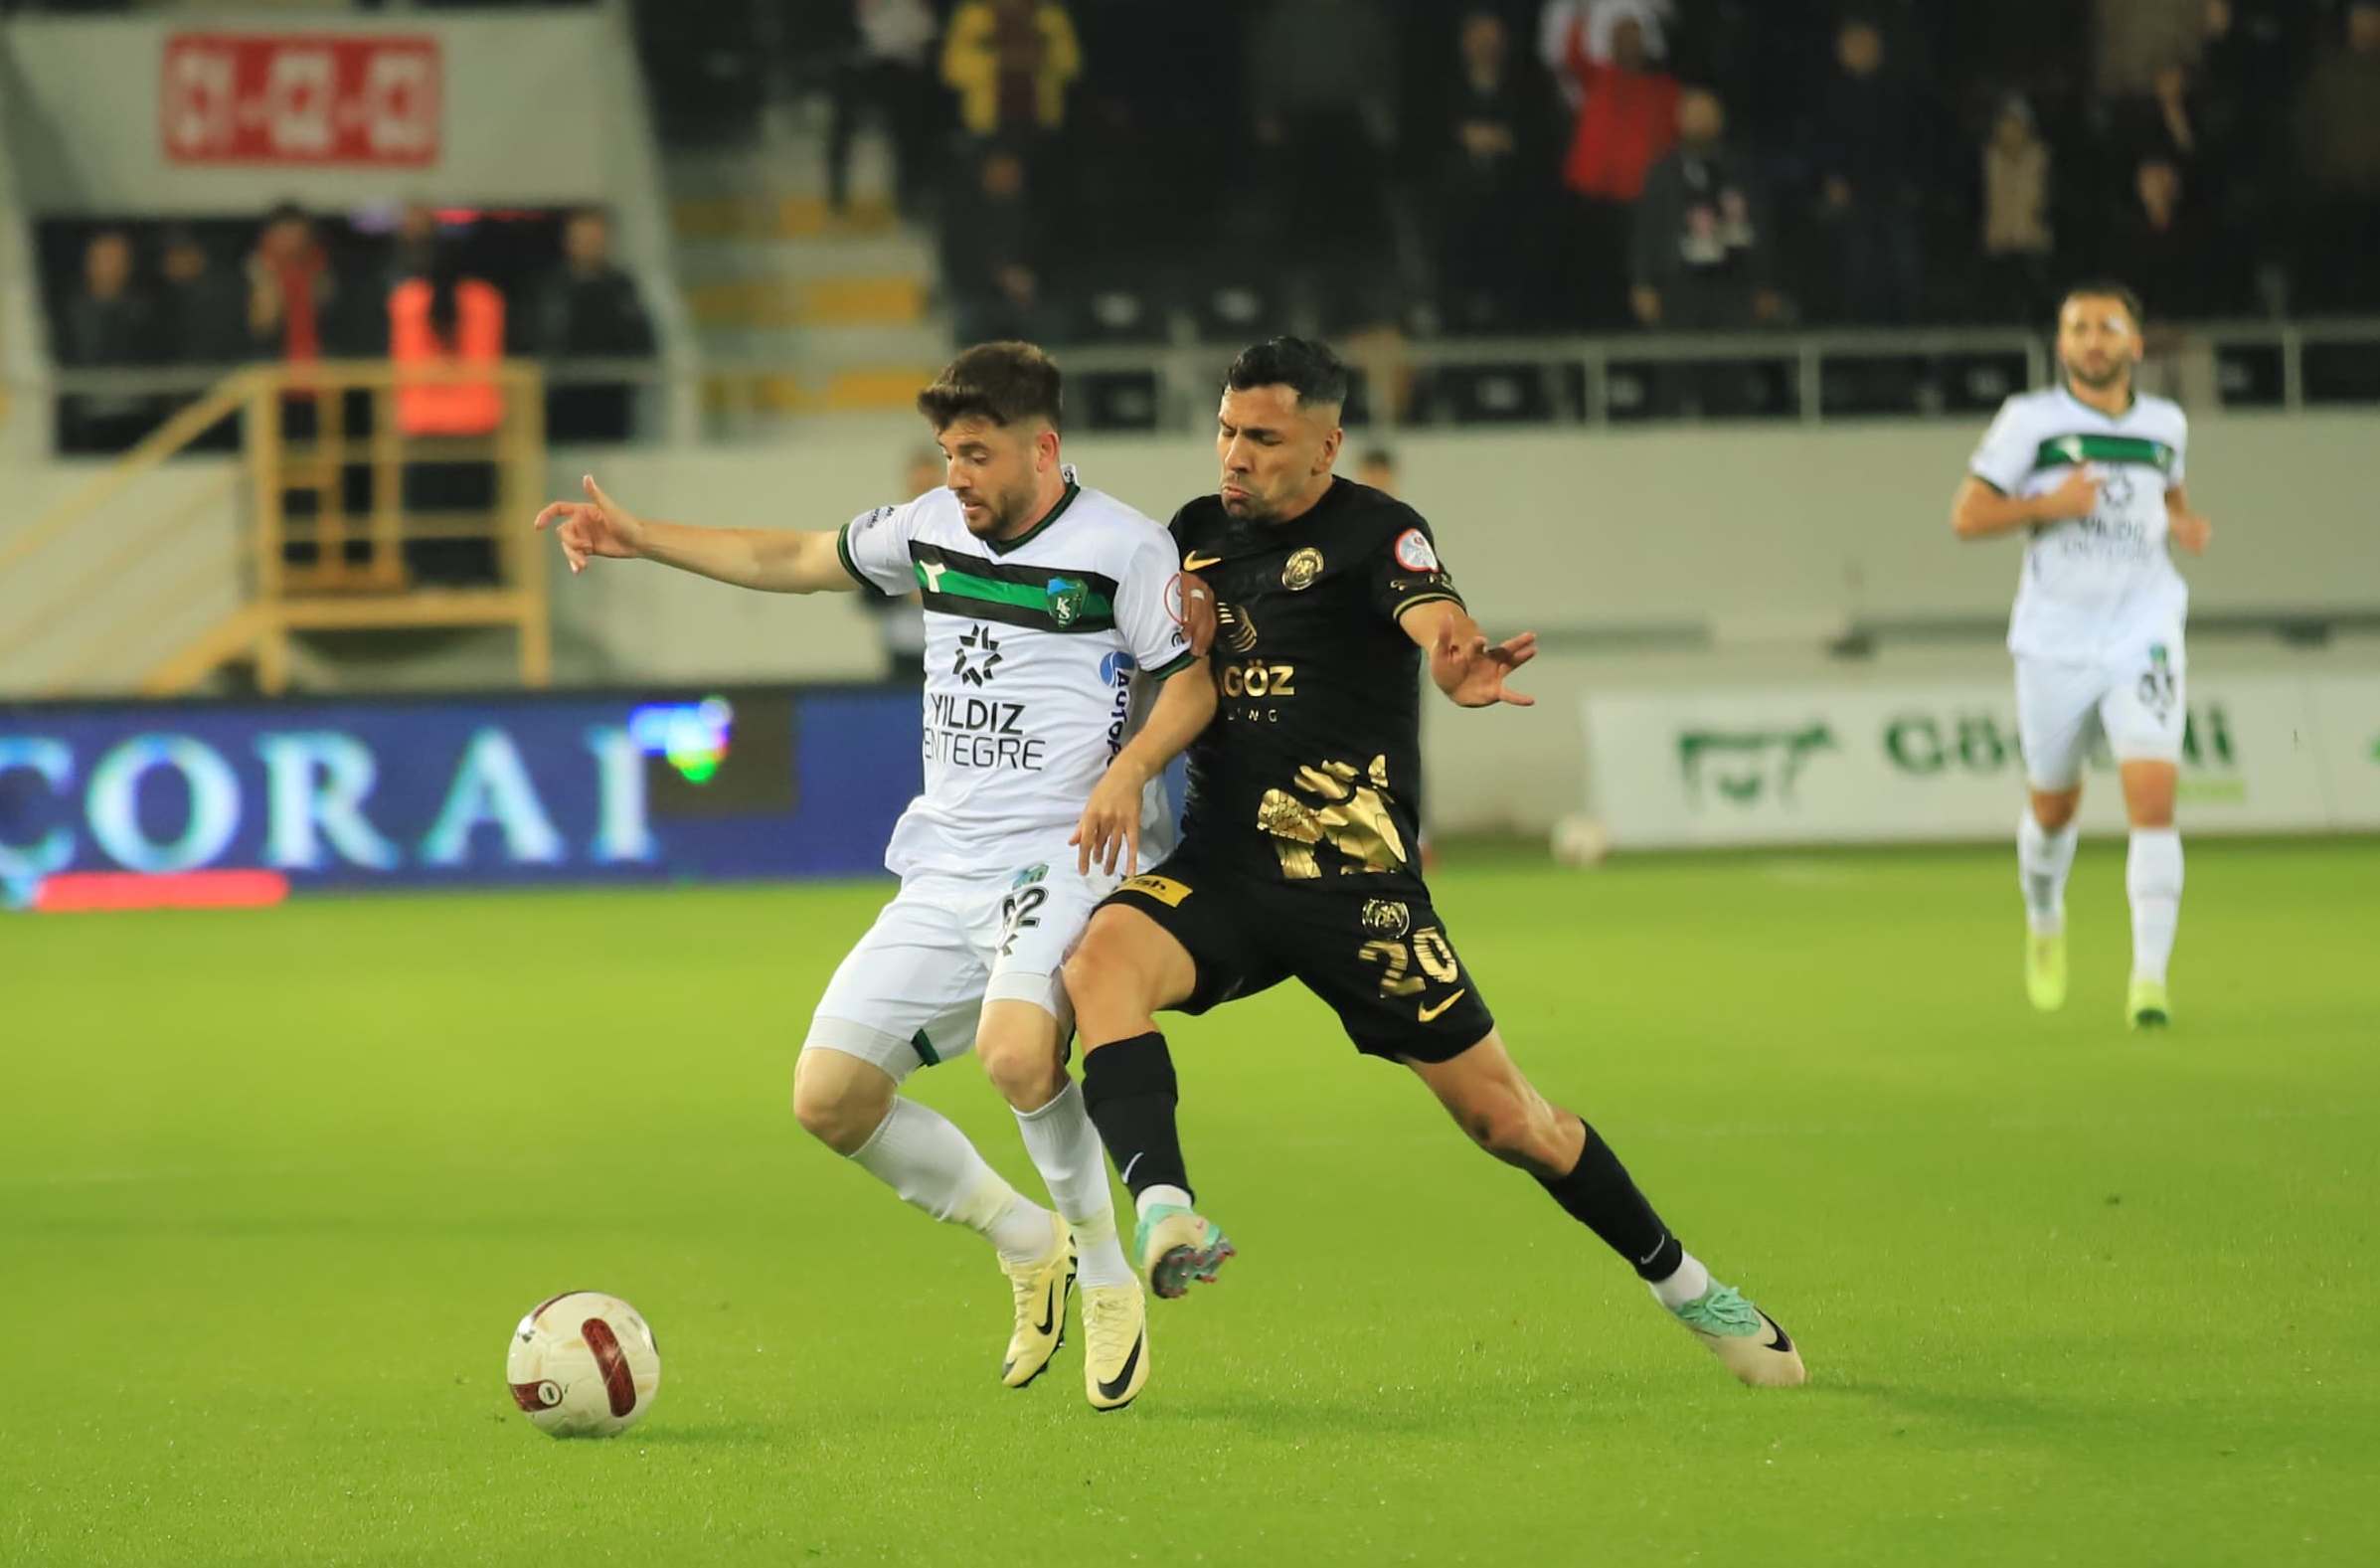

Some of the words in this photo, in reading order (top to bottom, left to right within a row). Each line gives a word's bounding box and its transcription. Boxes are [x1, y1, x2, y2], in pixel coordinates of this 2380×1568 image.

[1222, 658, 1294, 696] GÖZ
[931, 693, 1025, 735] YILDIZ
[924, 728, 1046, 771] ENTEGRE
[1358, 926, 1458, 997] 20
